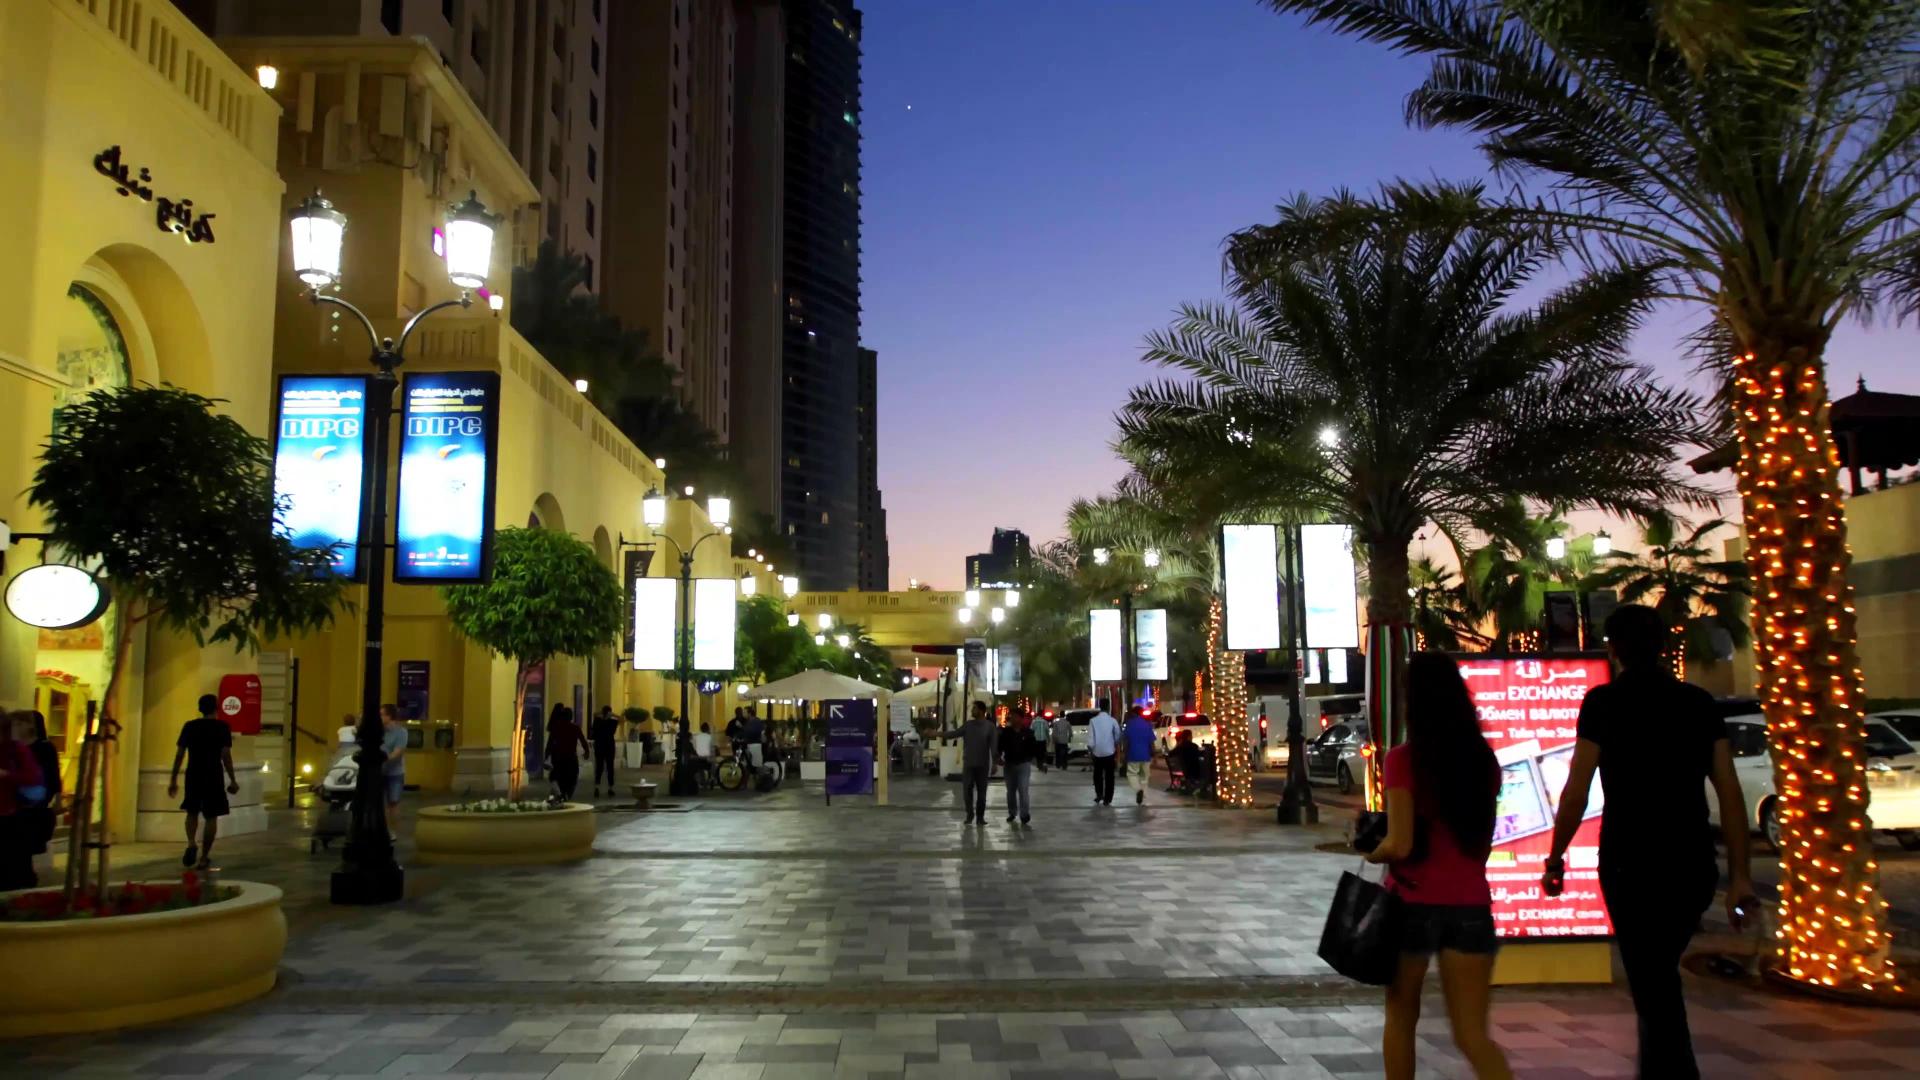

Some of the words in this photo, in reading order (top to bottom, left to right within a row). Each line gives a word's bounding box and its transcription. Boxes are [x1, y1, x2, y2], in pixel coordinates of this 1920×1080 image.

[282, 418, 359, 438] DIPC
[408, 416, 482, 436] DIPC
[1515, 660, 1587, 684] صرافة
[1507, 685, 1587, 701] EXCHANGE
[1536, 727, 1555, 738] the
